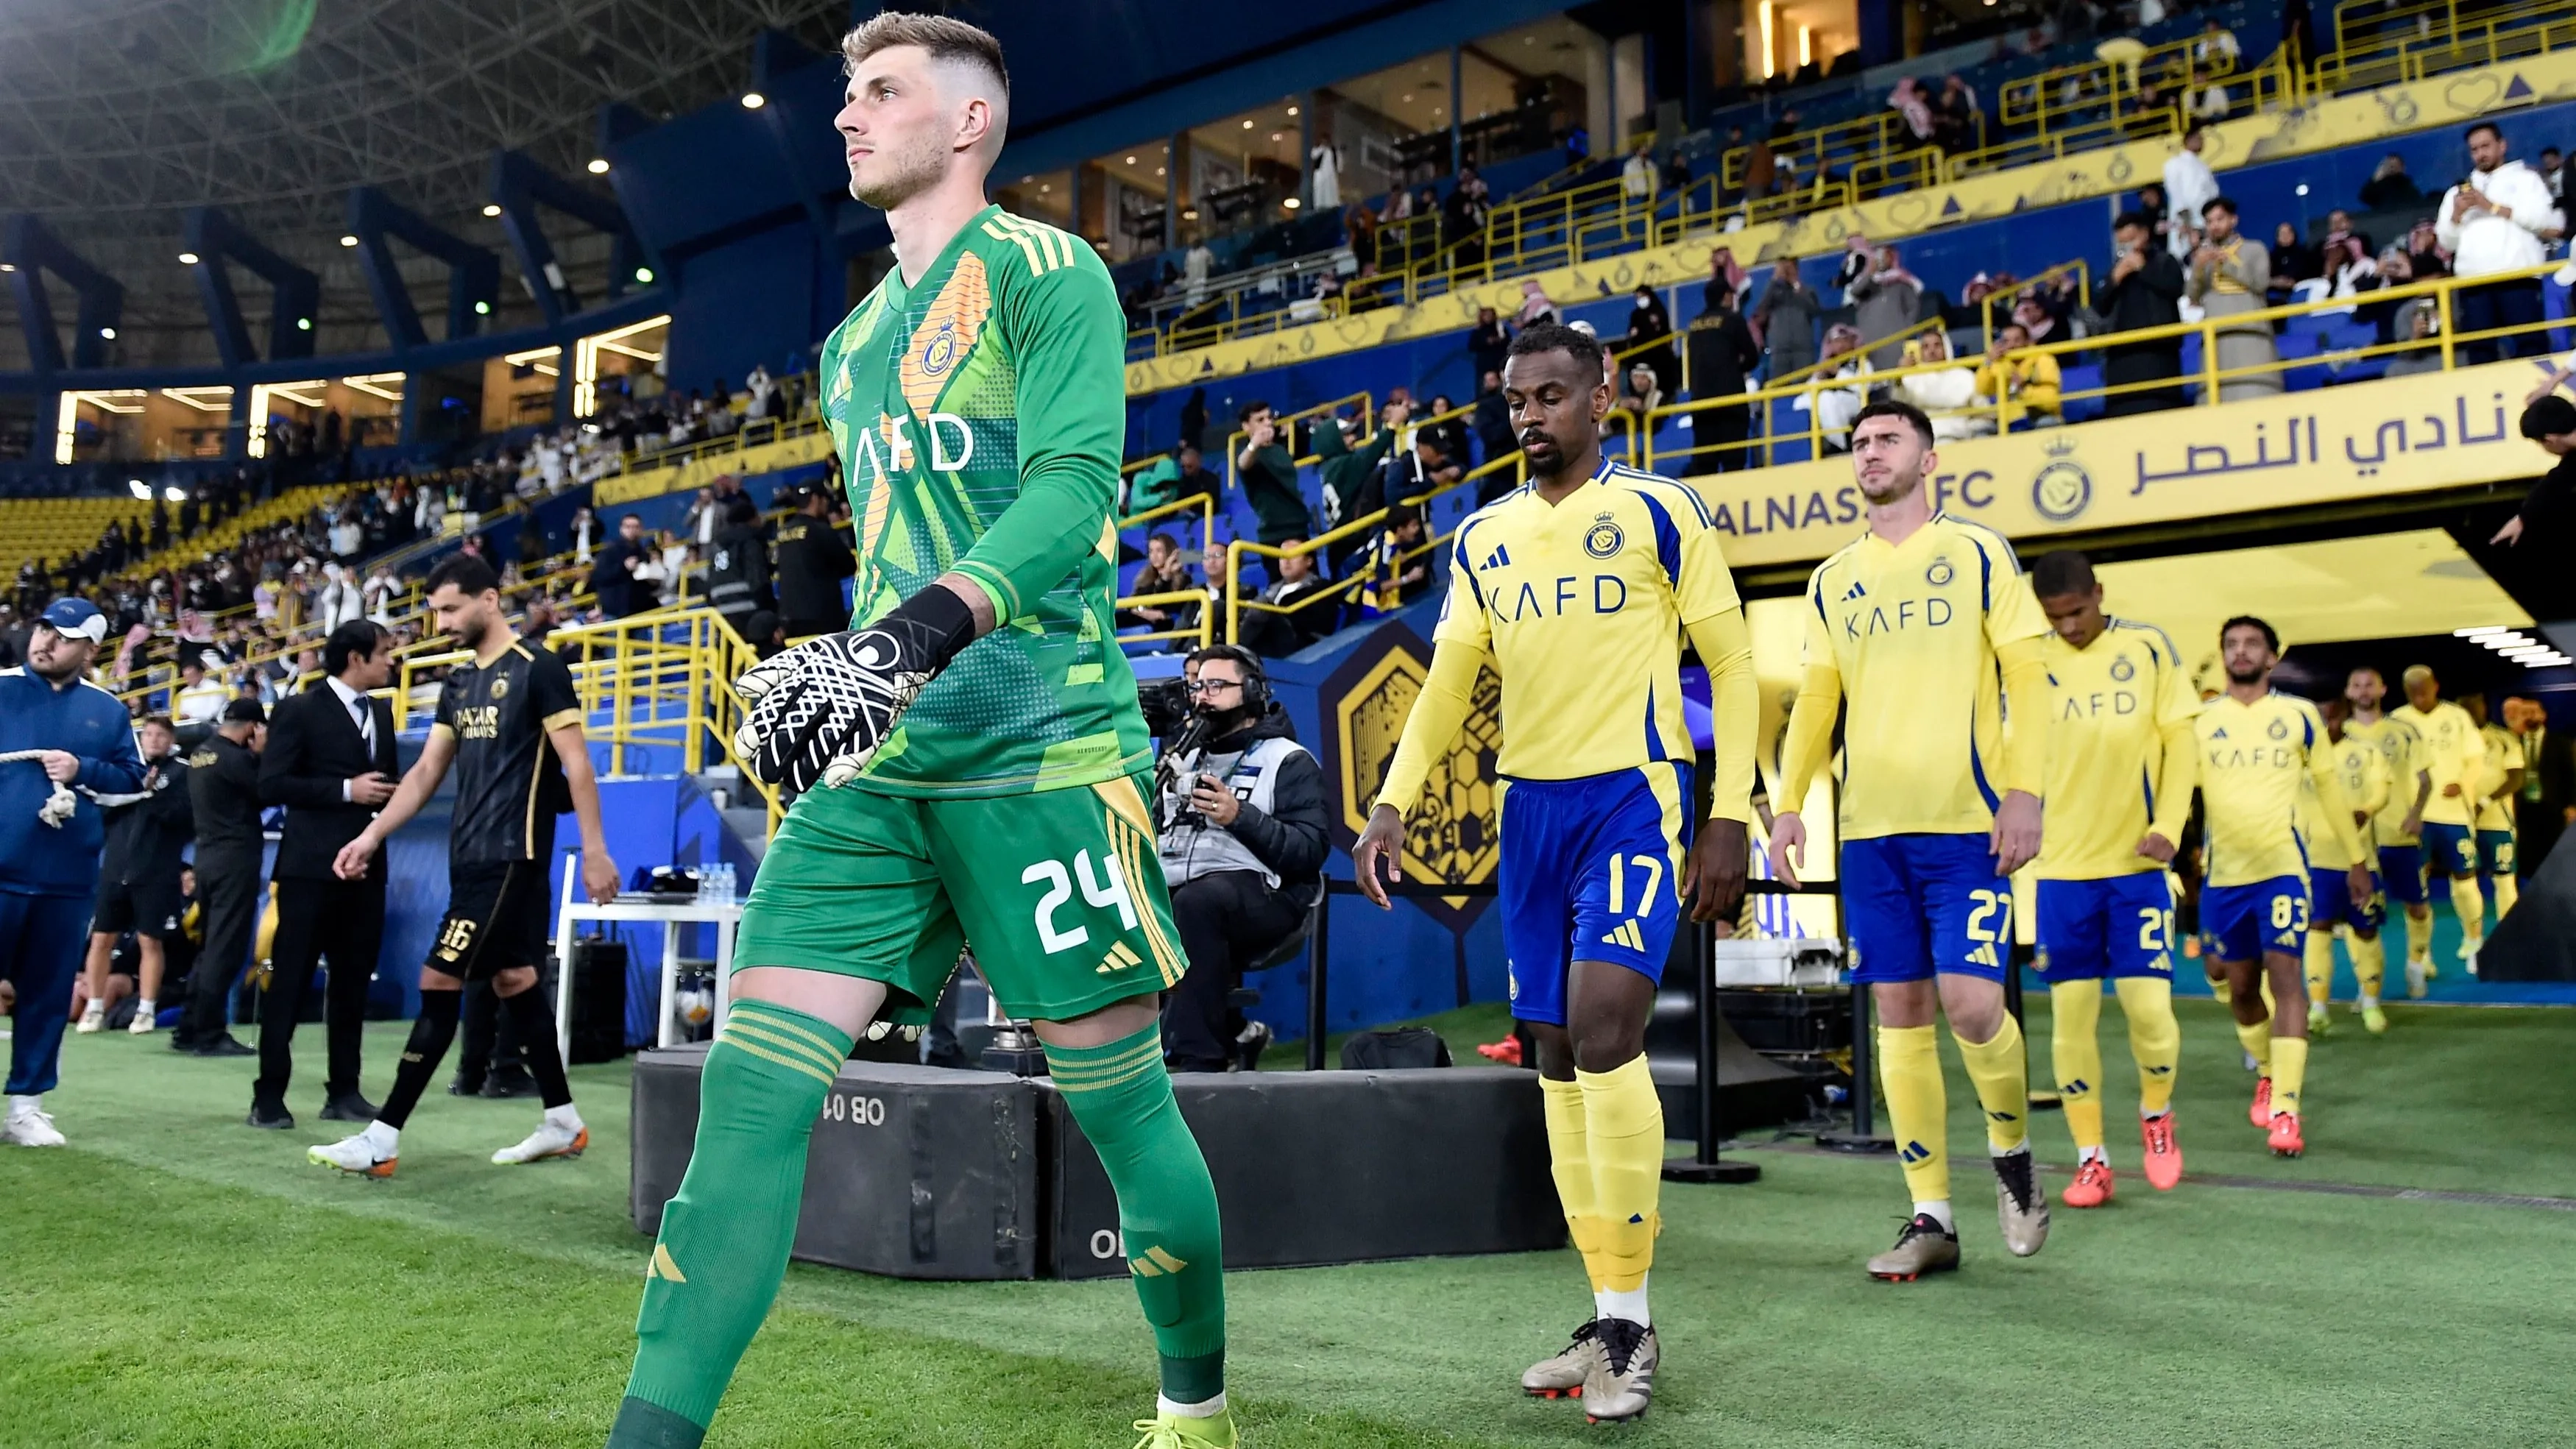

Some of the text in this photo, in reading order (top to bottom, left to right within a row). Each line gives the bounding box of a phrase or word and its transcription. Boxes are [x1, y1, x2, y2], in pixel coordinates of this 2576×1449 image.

[852, 412, 974, 487] AFD
[2129, 392, 2507, 496] نادي النصر
[1713, 471, 1994, 536] ALNAS FC
[1485, 575, 1627, 626] KAFD
[1845, 598, 1952, 642] KAFD
[2064, 691, 2137, 720] AFD
[2208, 746, 2290, 770] KAFD
[1021, 848, 1138, 954] 24
[1609, 852, 1663, 918] 17
[439, 918, 477, 951] 16
[1967, 888, 2013, 944] 27
[2271, 894, 2309, 932] 83
[851, 1095, 885, 1126] OB
